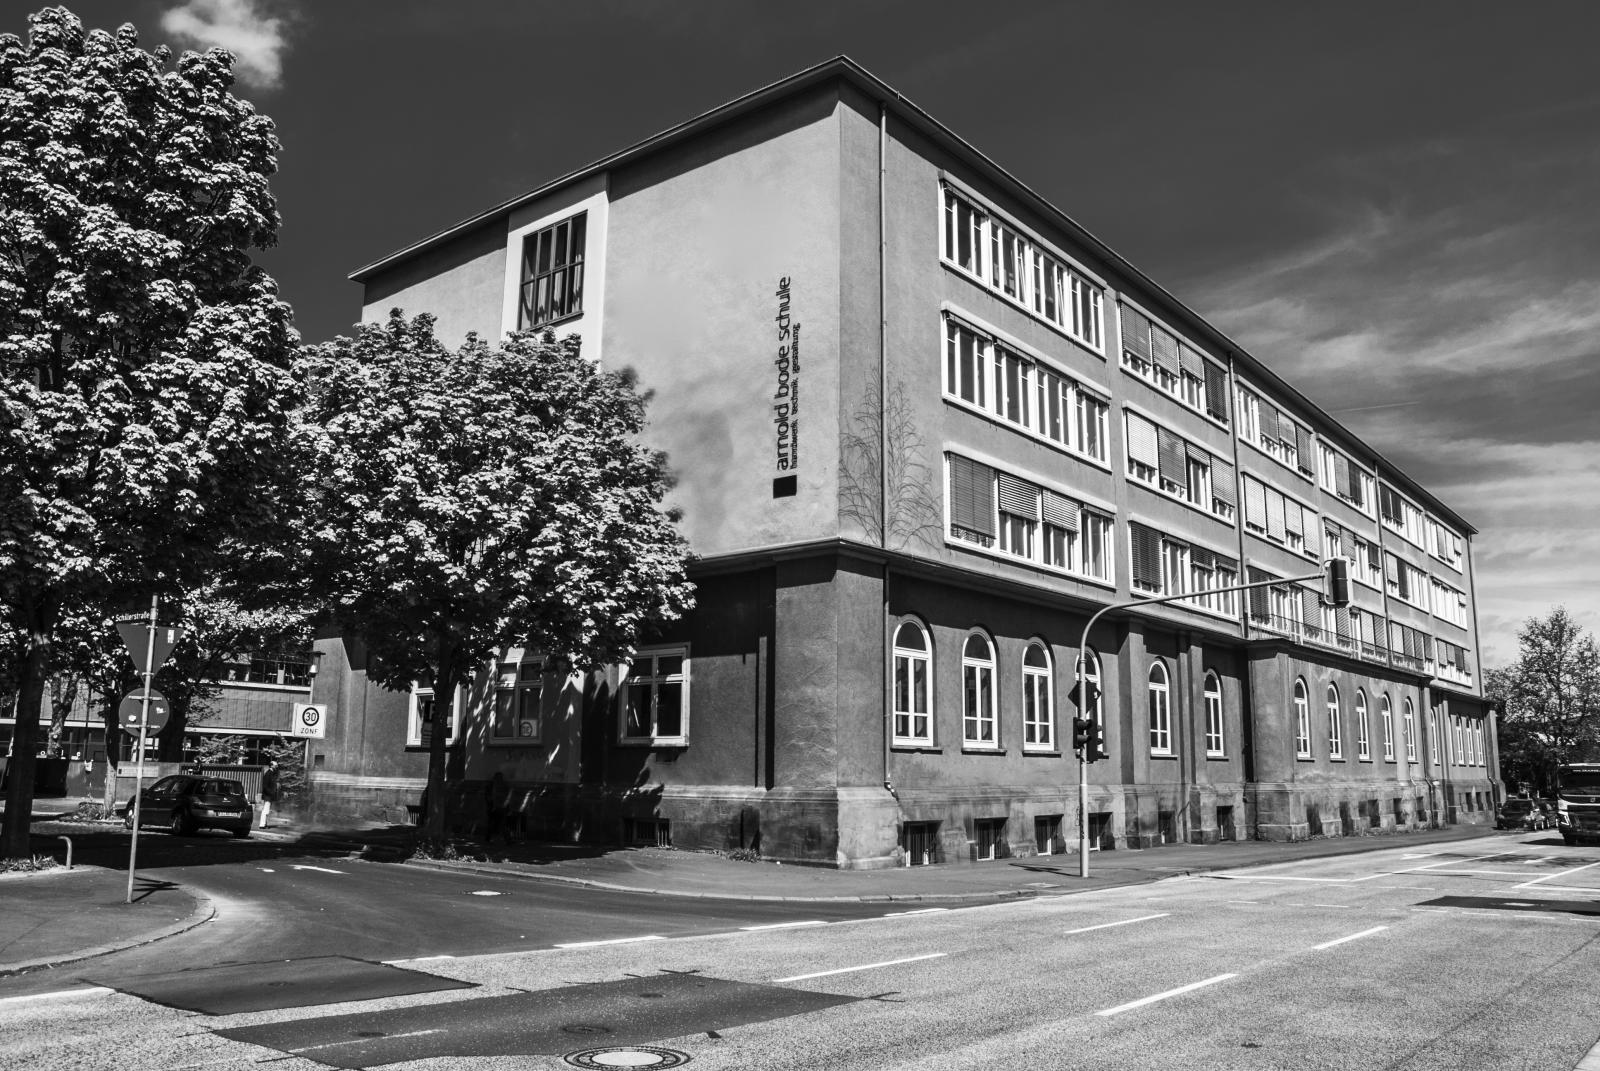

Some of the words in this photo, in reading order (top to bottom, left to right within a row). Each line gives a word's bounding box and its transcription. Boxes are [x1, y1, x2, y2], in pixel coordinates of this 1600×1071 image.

[775, 276, 791, 340] schule
[774, 345, 789, 398] bode
[774, 403, 789, 470] arnold
[306, 712, 316, 721] 30
